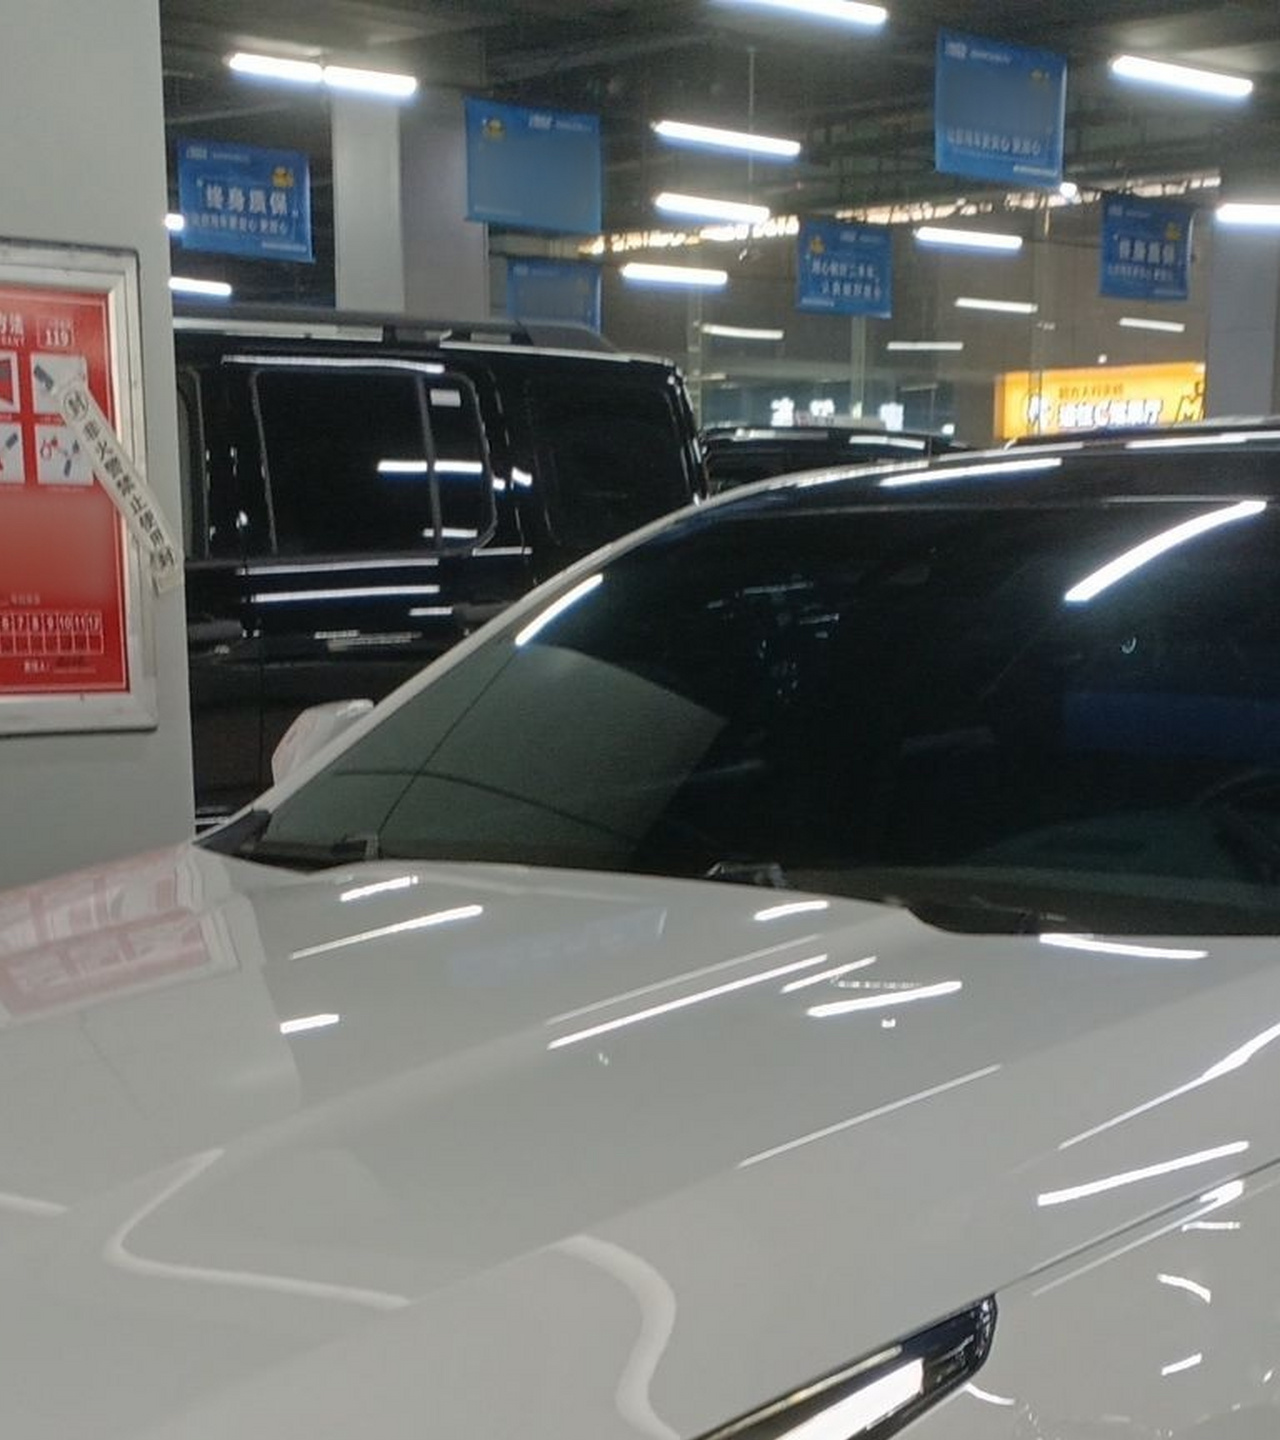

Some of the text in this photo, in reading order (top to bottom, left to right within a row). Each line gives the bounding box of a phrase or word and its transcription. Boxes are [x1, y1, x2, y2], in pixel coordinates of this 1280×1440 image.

[206, 183, 288, 215] 终身质保
[46, 329, 70, 347] 119
